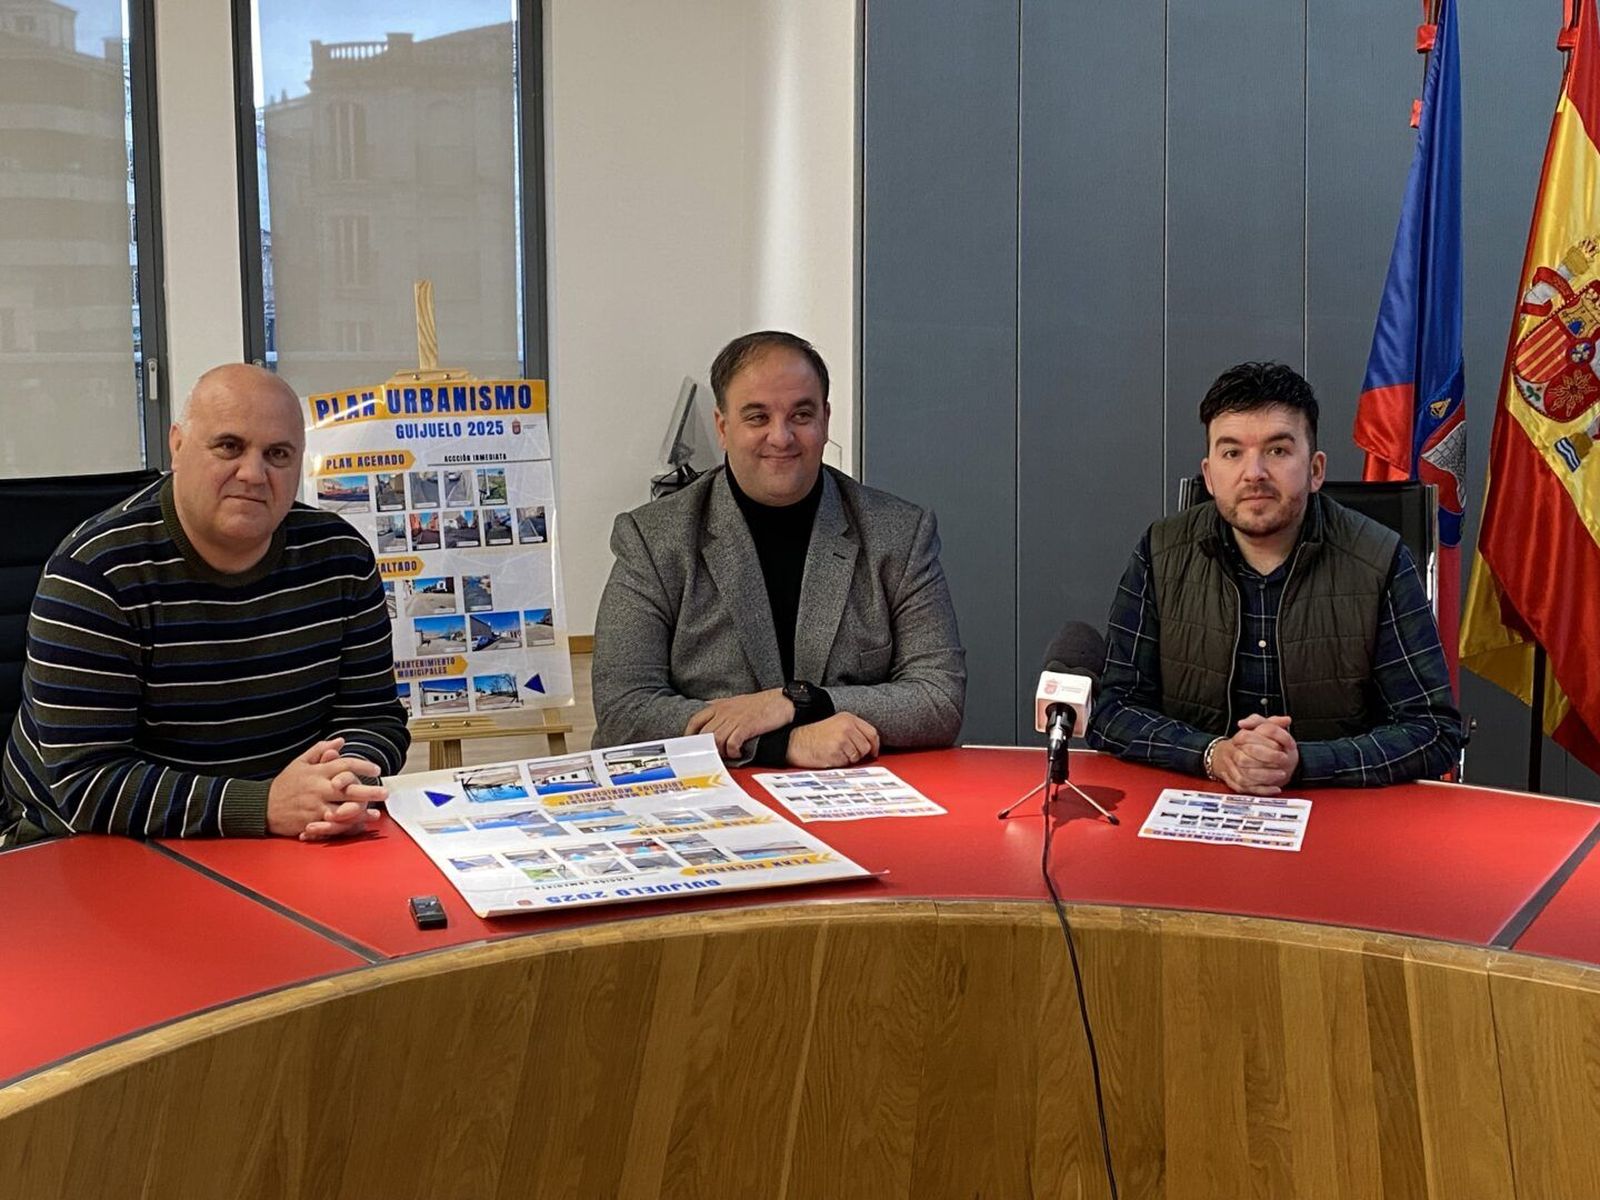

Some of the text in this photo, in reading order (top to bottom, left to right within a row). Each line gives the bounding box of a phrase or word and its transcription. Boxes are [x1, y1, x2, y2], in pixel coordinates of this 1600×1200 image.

[315, 384, 532, 421] PLAN URBANISMO
[396, 422, 462, 439] GUIJUELO
[467, 420, 504, 436] 2025
[326, 454, 405, 470] PLAN ACERADO
[473, 453, 507, 461] INMEDIATA
[376, 561, 417, 573] ALTADO
[394, 657, 455, 669] MANTENIMIENTO
[398, 667, 447, 678] MUNICIPALES
[546, 879, 722, 903] GUIJUELO 2025
